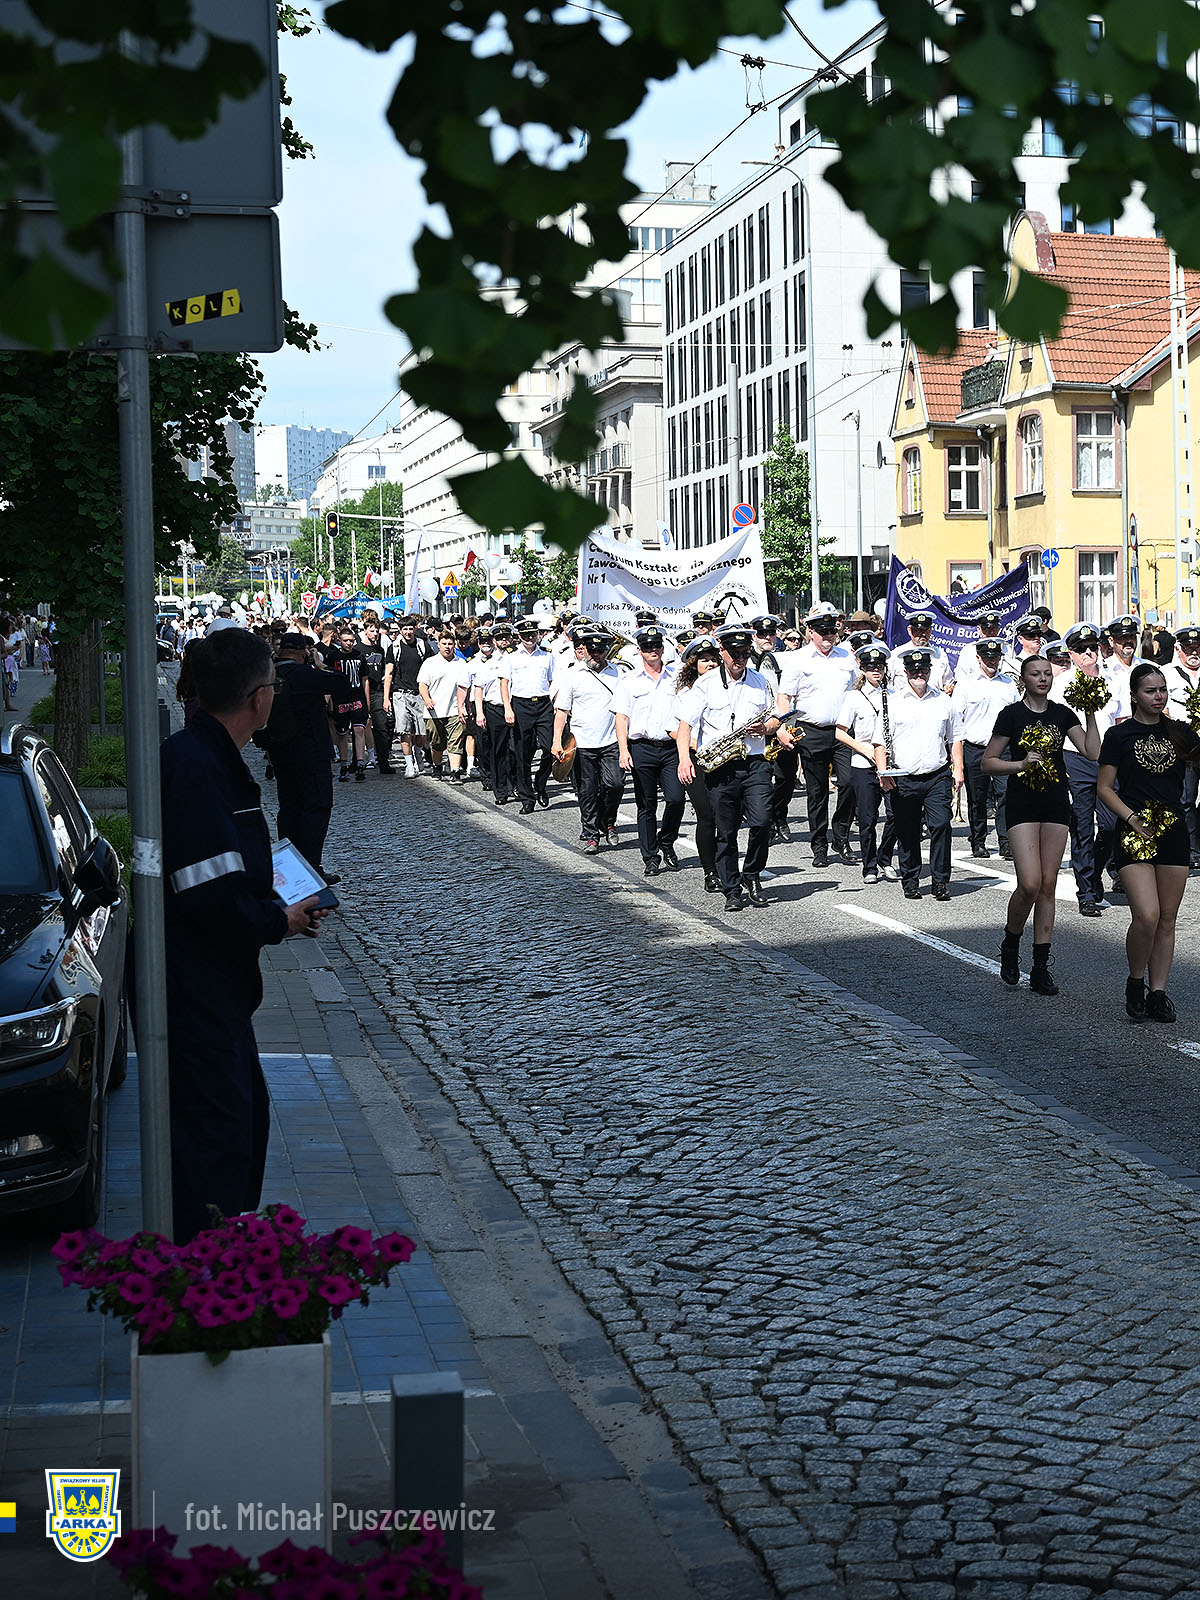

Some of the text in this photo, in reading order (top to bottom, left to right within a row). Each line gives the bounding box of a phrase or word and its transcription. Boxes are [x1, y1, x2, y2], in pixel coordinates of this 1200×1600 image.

[171, 296, 235, 319] KOLT
[635, 557, 704, 573] Kształcia
[587, 573, 606, 585] Nr 1
[592, 603, 620, 611] Morska
[662, 606, 691, 616] Gdynia
[1150, 764, 1164, 774] 30
